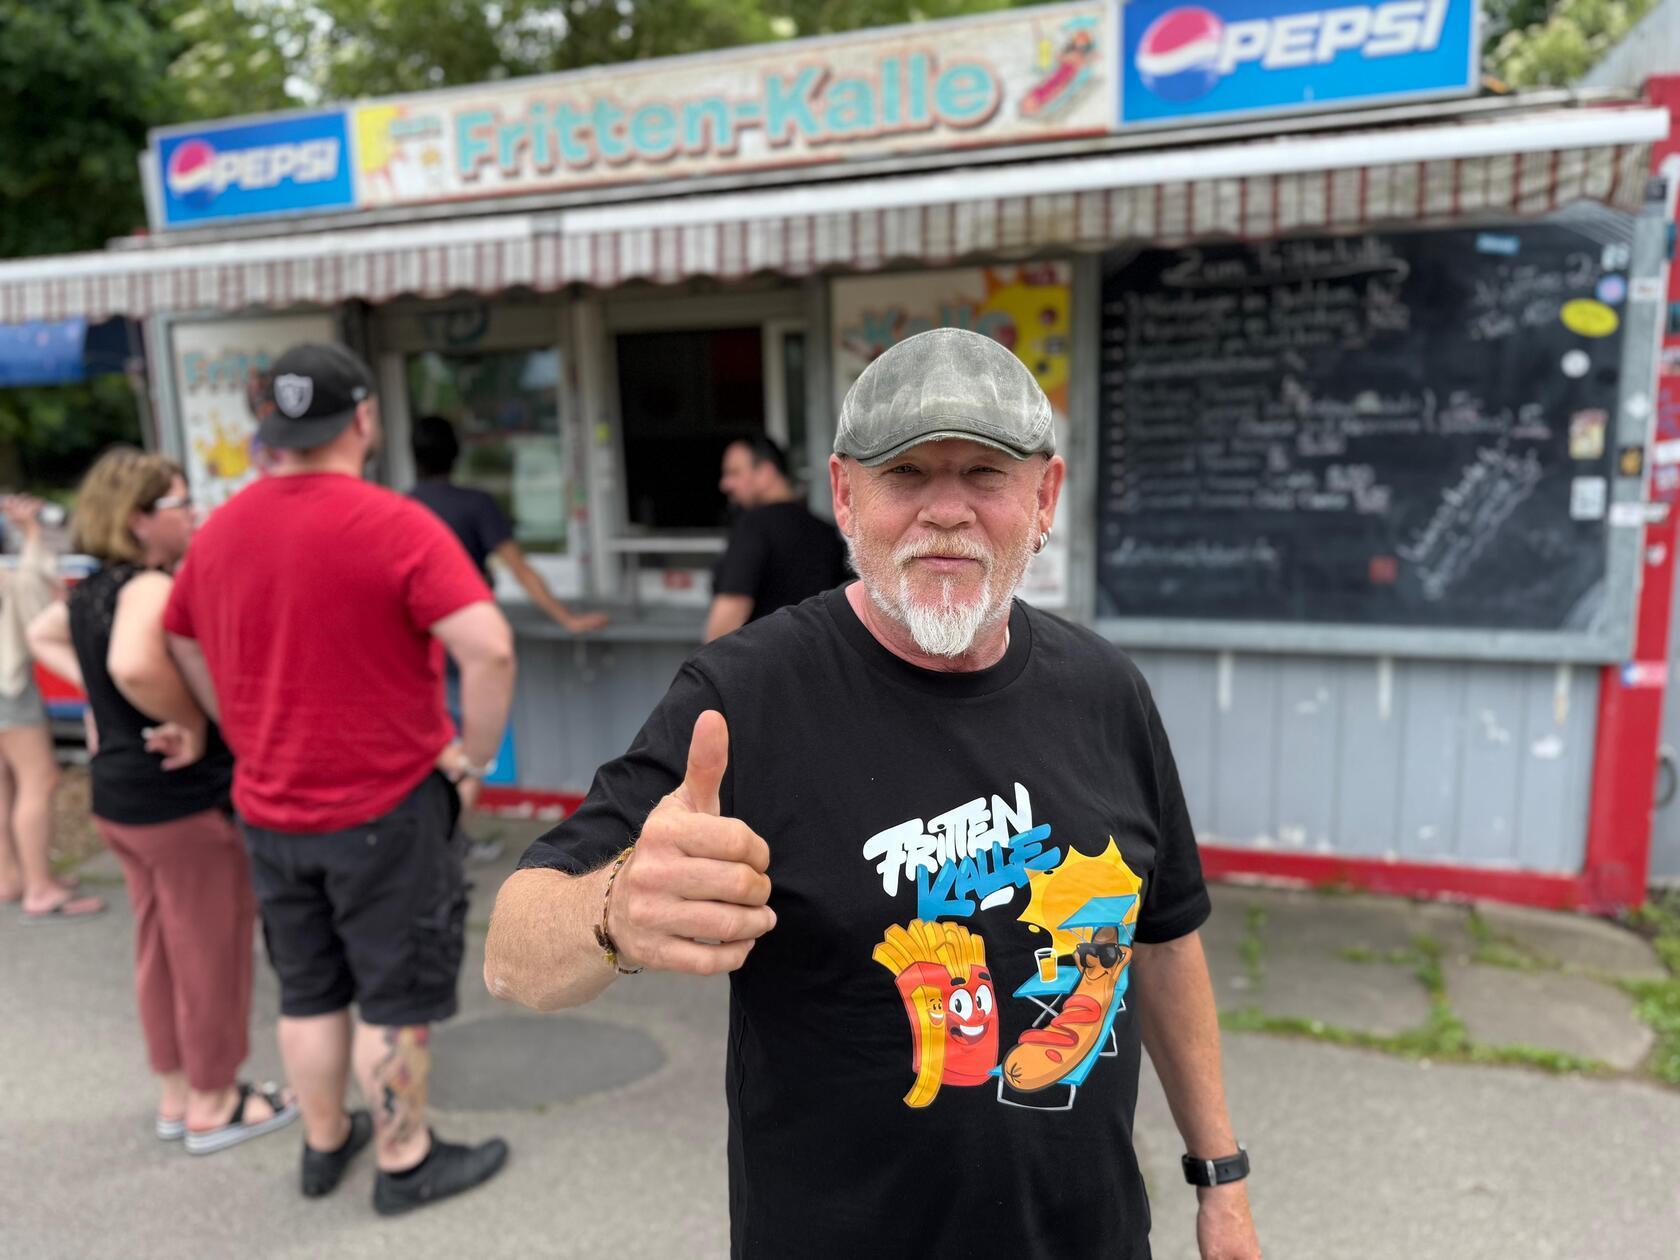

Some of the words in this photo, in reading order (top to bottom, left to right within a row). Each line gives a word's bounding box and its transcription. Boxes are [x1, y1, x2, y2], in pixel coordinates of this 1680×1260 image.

[1218, 0, 1450, 74] PEPSI
[453, 50, 1000, 181] Fritten-Kalle
[211, 138, 340, 192] PEPSI
[916, 823, 1061, 923] KALLE
